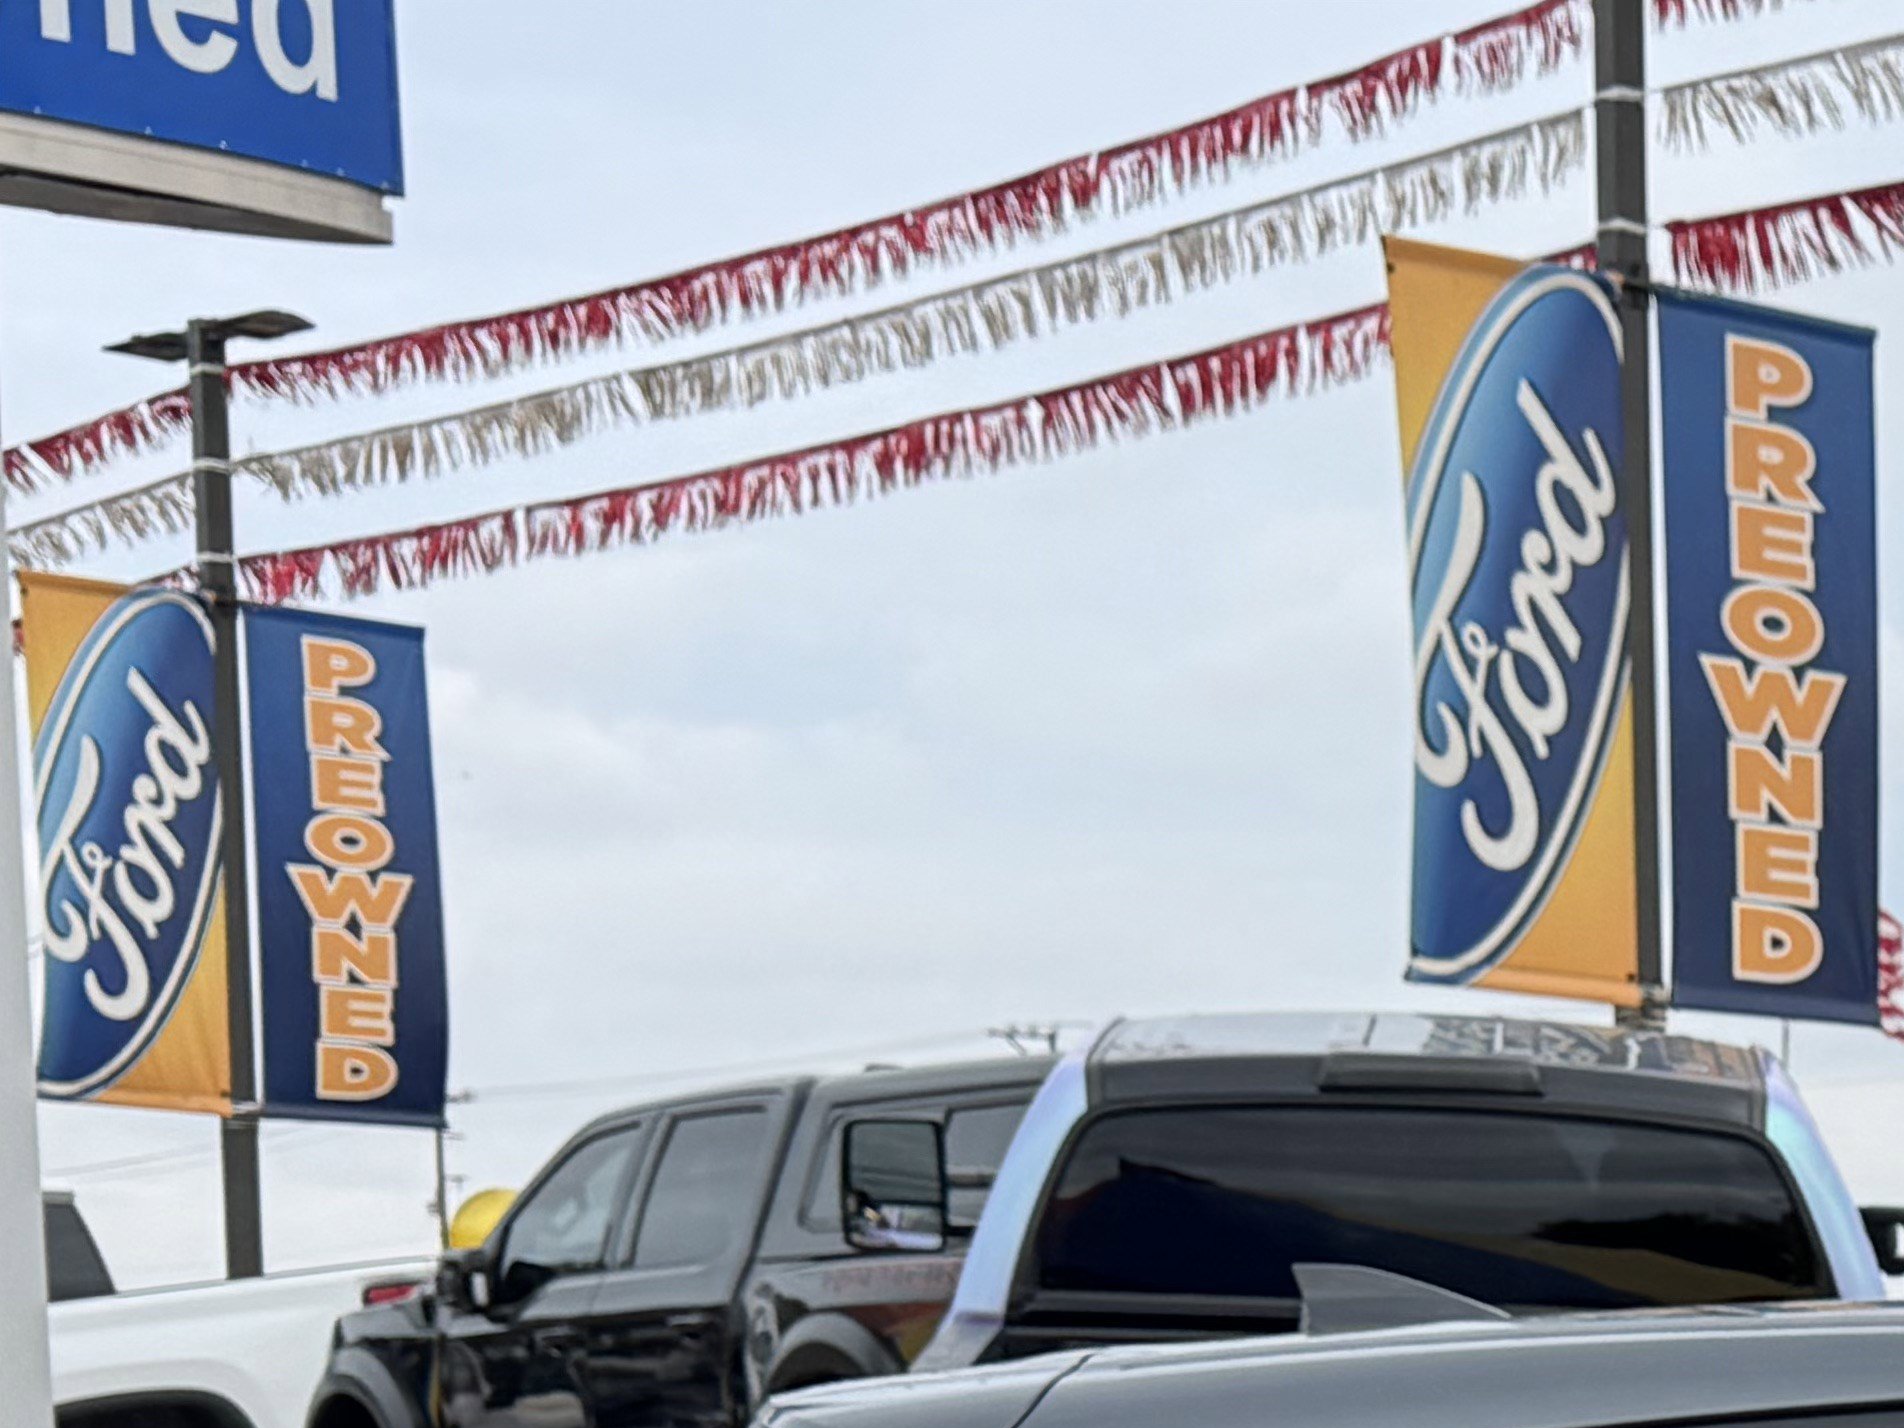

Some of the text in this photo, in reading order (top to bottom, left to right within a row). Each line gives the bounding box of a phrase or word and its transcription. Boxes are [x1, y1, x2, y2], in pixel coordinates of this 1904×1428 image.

[41, 666, 211, 1021] Ford
[1416, 377, 1617, 873] Ford
[1698, 331, 1848, 986] PREOWNED
[285, 633, 415, 1102] PREOWNED
